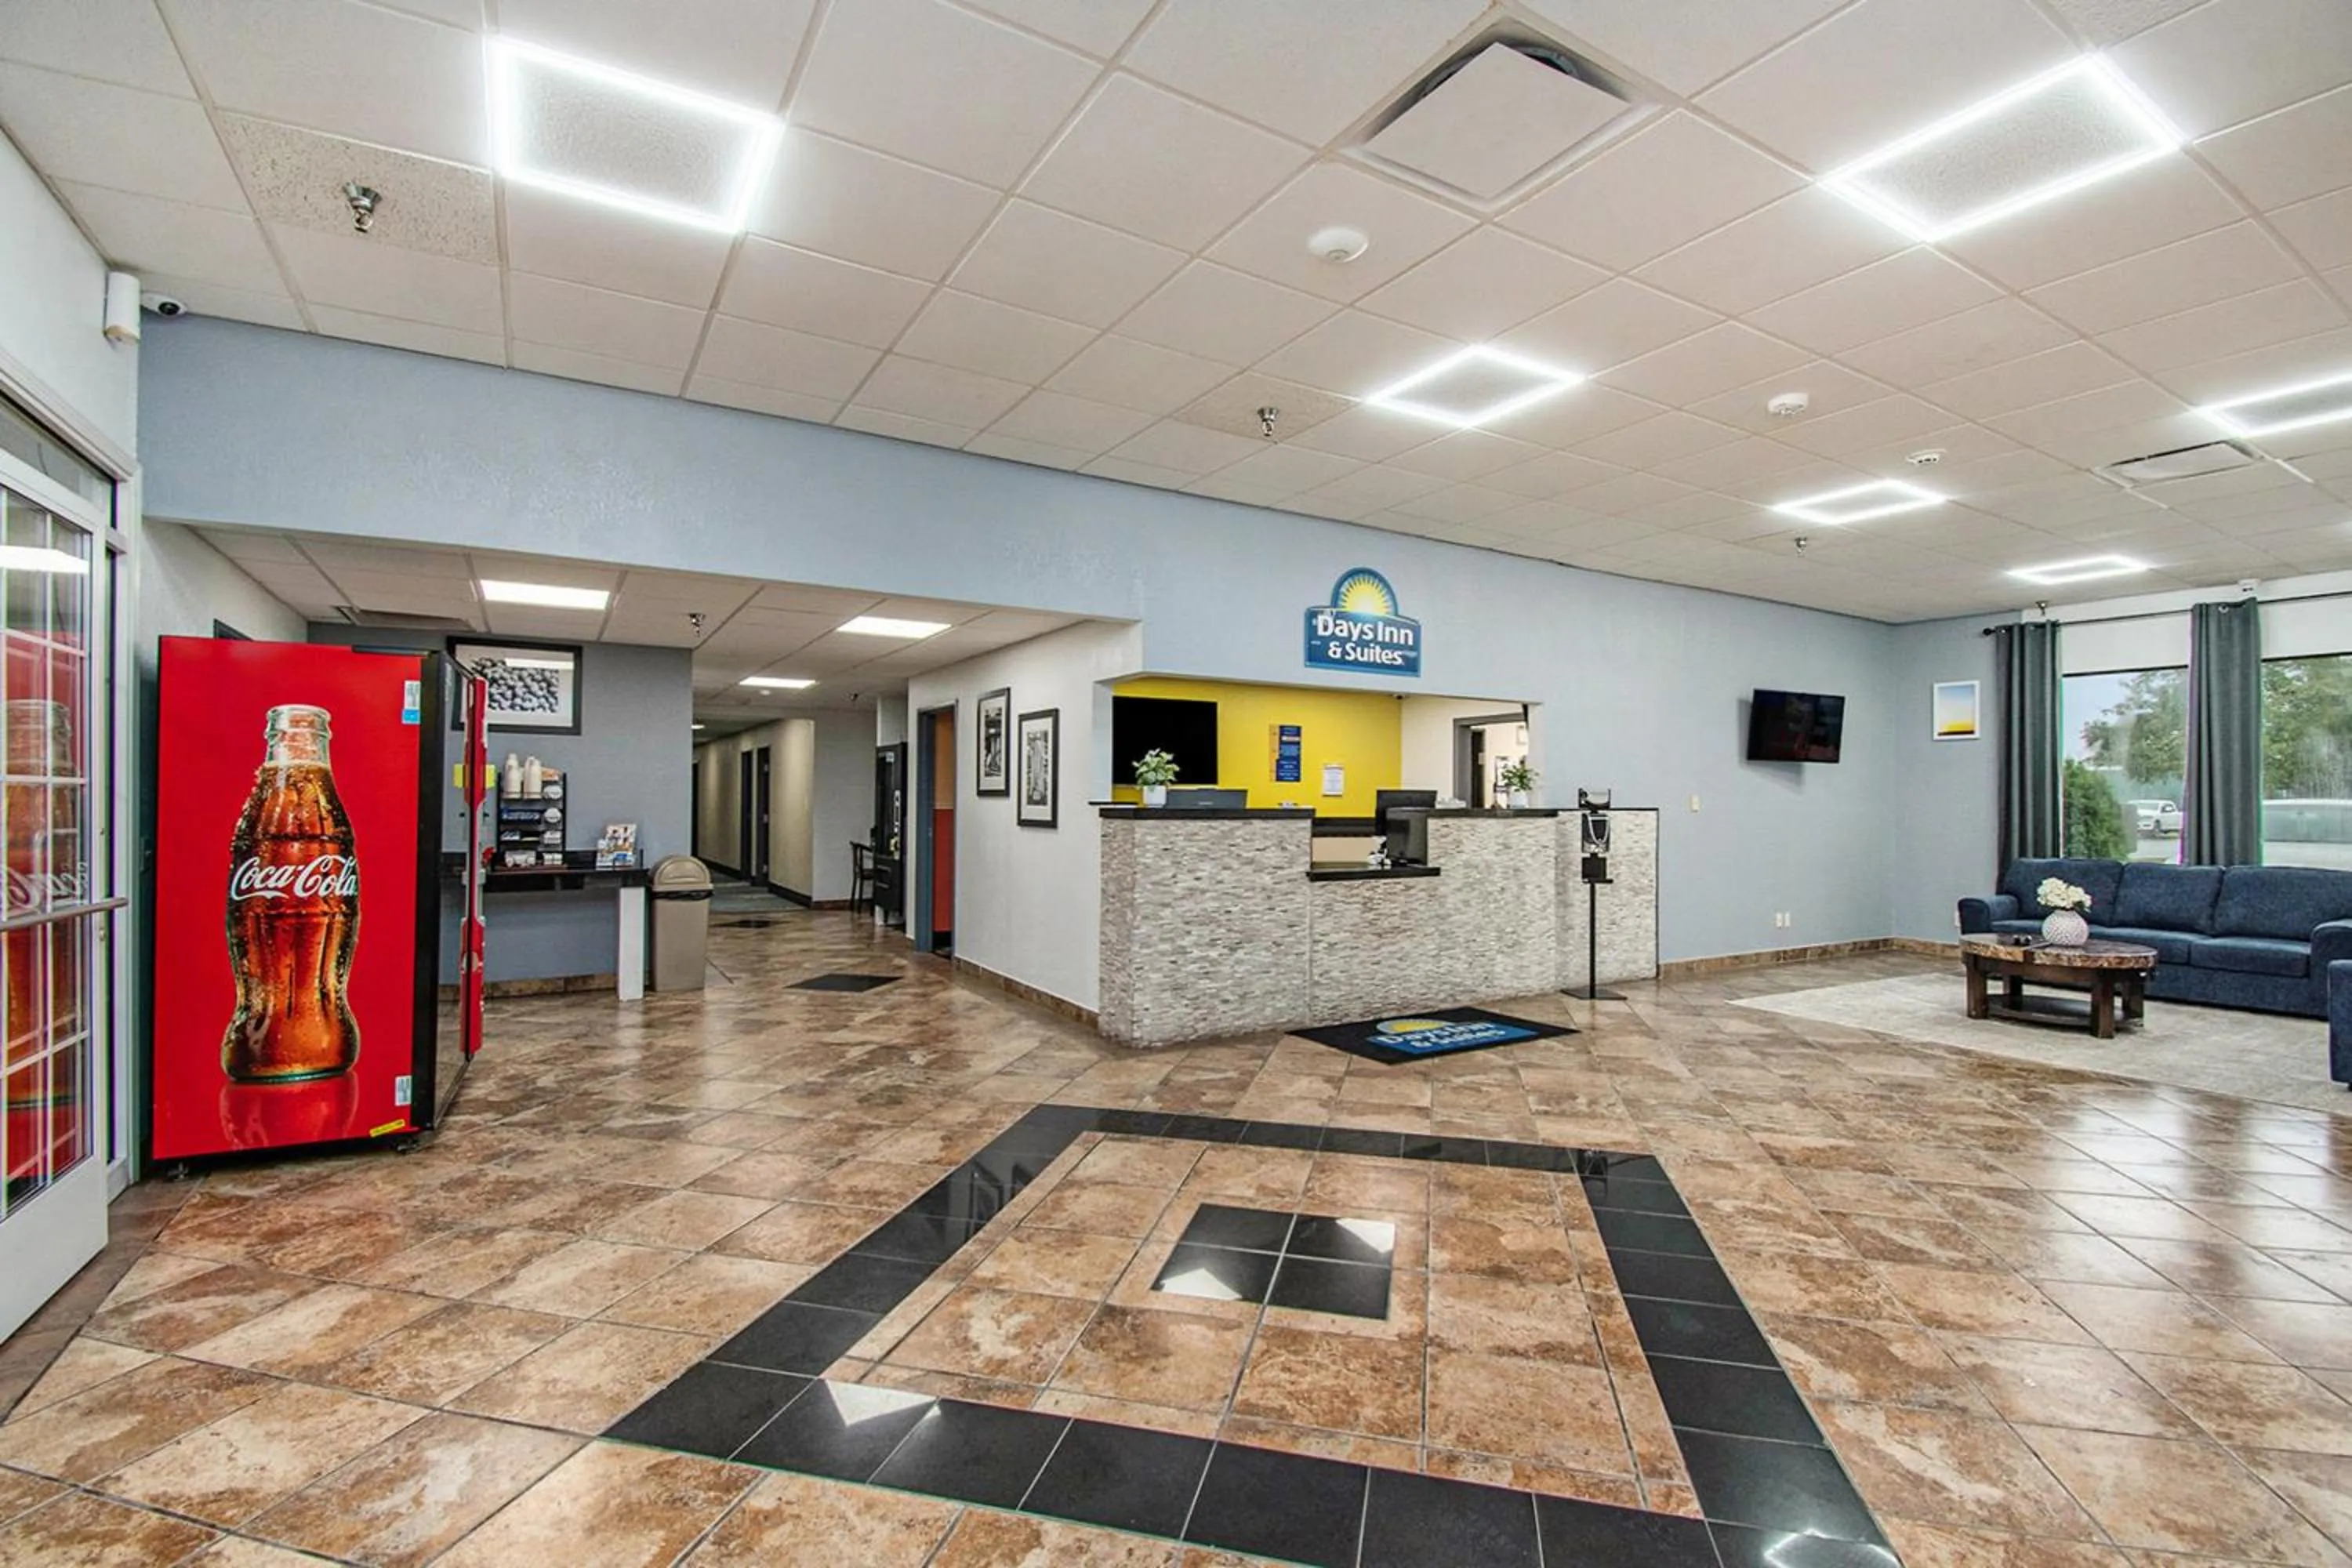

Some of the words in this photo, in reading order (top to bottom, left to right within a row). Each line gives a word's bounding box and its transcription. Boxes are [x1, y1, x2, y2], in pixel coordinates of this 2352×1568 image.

[1316, 615, 1374, 641] Days
[1377, 621, 1414, 646] Inn
[1328, 641, 1342, 659] &
[1345, 643, 1403, 665] Suites
[230, 855, 358, 901] Coca-Cola
